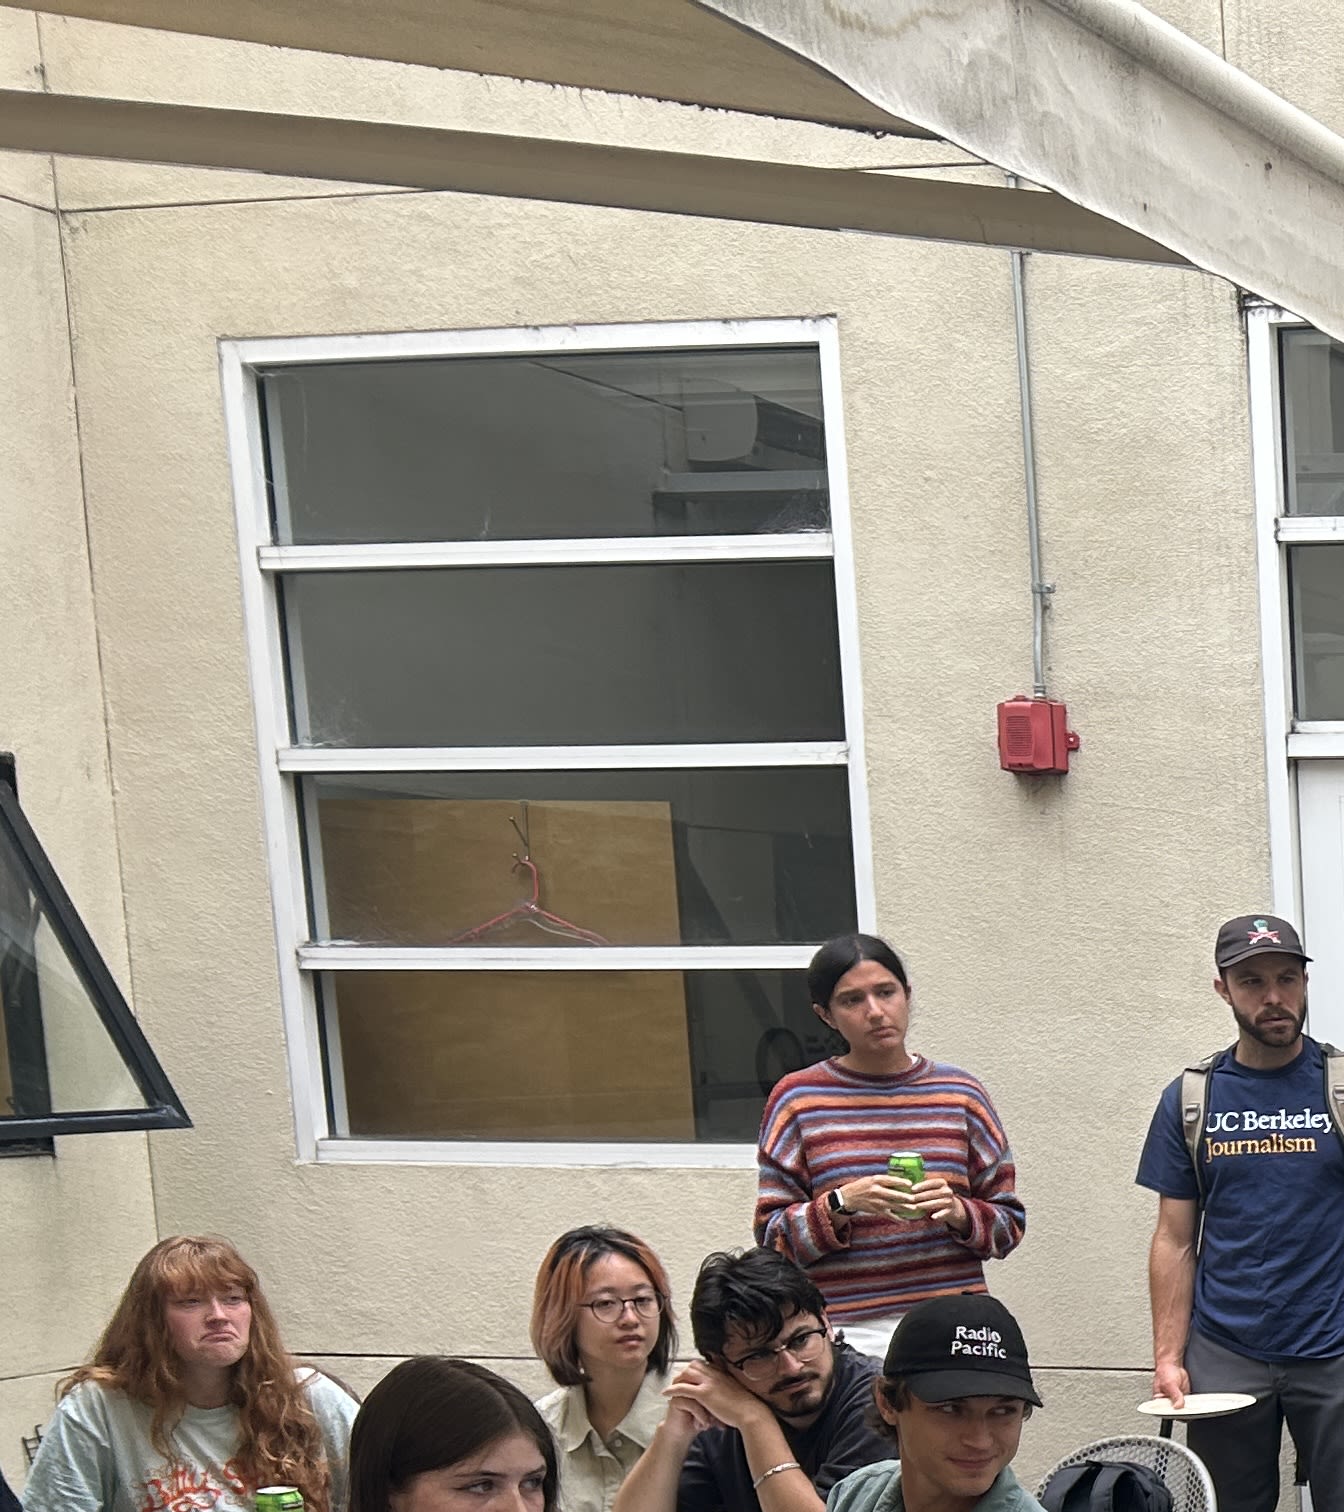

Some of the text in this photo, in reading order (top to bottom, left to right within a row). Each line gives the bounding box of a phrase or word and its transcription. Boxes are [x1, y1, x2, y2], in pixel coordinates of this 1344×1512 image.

[1206, 1107, 1333, 1134] UC Berkeley
[1205, 1133, 1317, 1164] Journalism
[955, 1325, 1002, 1343] Radio
[951, 1340, 1007, 1359] Pacific
